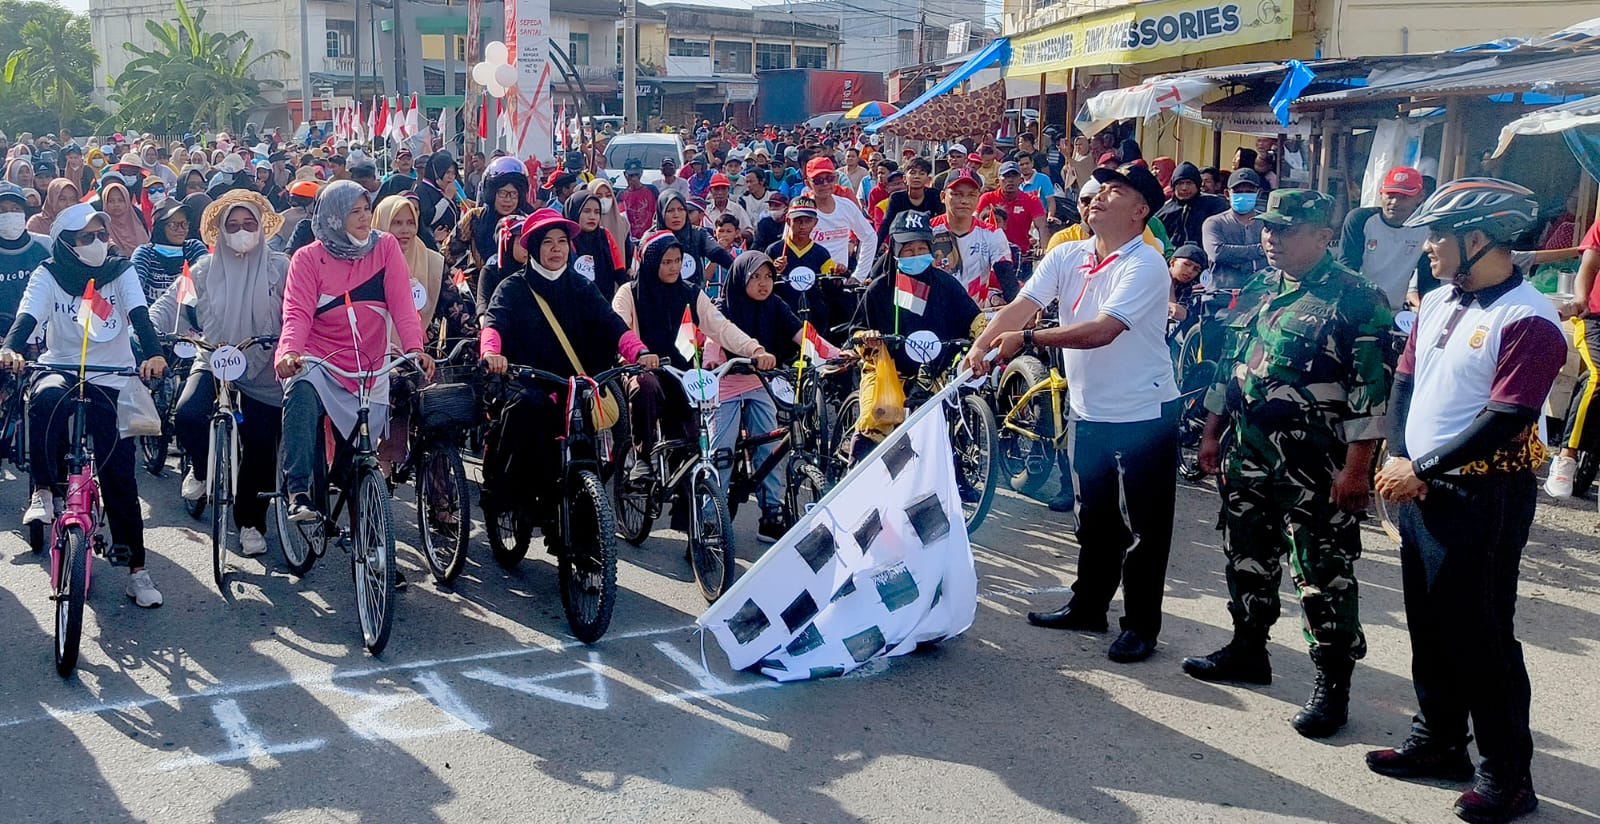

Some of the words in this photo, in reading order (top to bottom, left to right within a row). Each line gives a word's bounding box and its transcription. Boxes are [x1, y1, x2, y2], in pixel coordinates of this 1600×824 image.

[520, 28, 542, 36] SANTAI
[1105, 3, 1240, 50] ACCESSORIES
[213, 356, 241, 369] 0260
